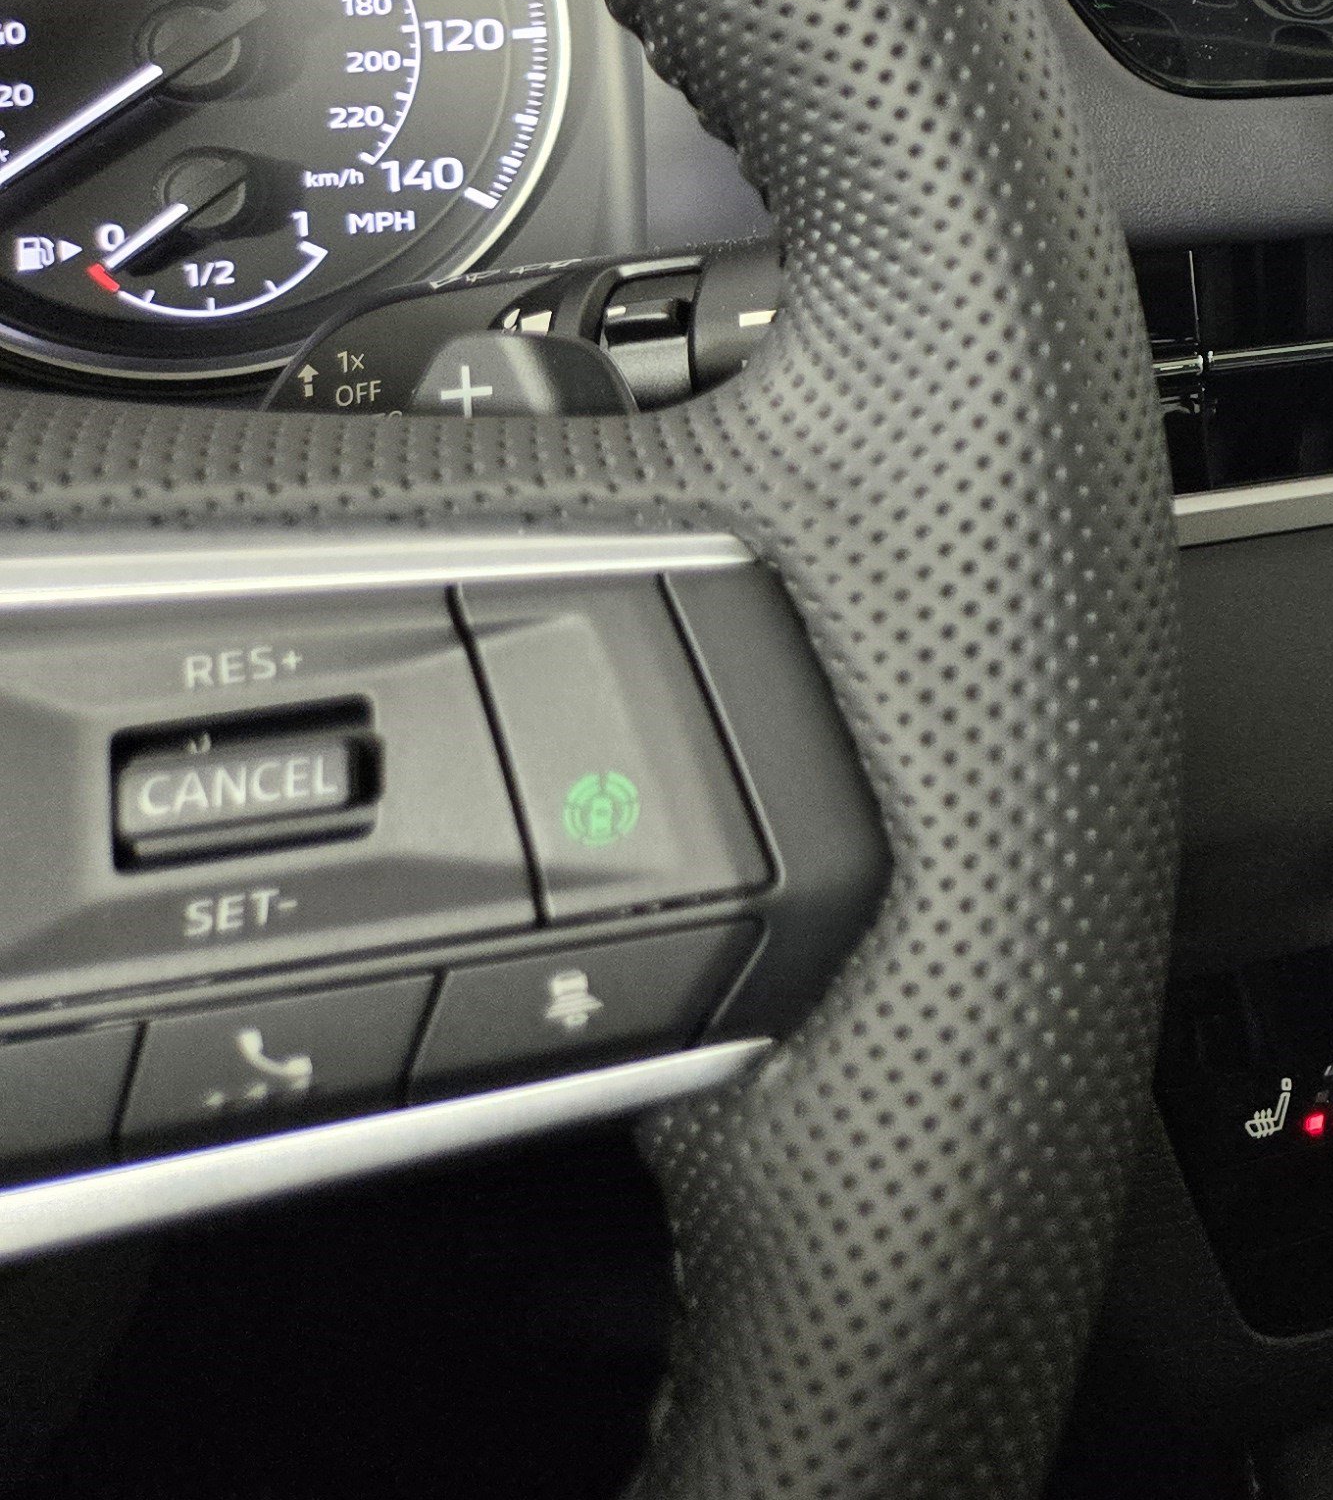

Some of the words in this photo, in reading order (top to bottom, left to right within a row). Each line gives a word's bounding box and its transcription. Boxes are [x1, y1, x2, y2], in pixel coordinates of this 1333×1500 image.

[0, 21, 27, 45] 0
[423, 19, 505, 52] 120
[345, 50, 402, 73] 200
[328, 105, 385, 129] 220
[304, 166, 365, 190] km/h
[380, 156, 464, 191] 140
[291, 211, 310, 238] 1
[347, 209, 416, 234] MPH
[99, 225, 127, 250] 0
[182, 260, 236, 287] 1/2
[335, 380, 382, 407] OFF
[183, 644, 304, 690] RES+
[137, 755, 340, 817] CANCEL
[183, 887, 299, 938] SET-
